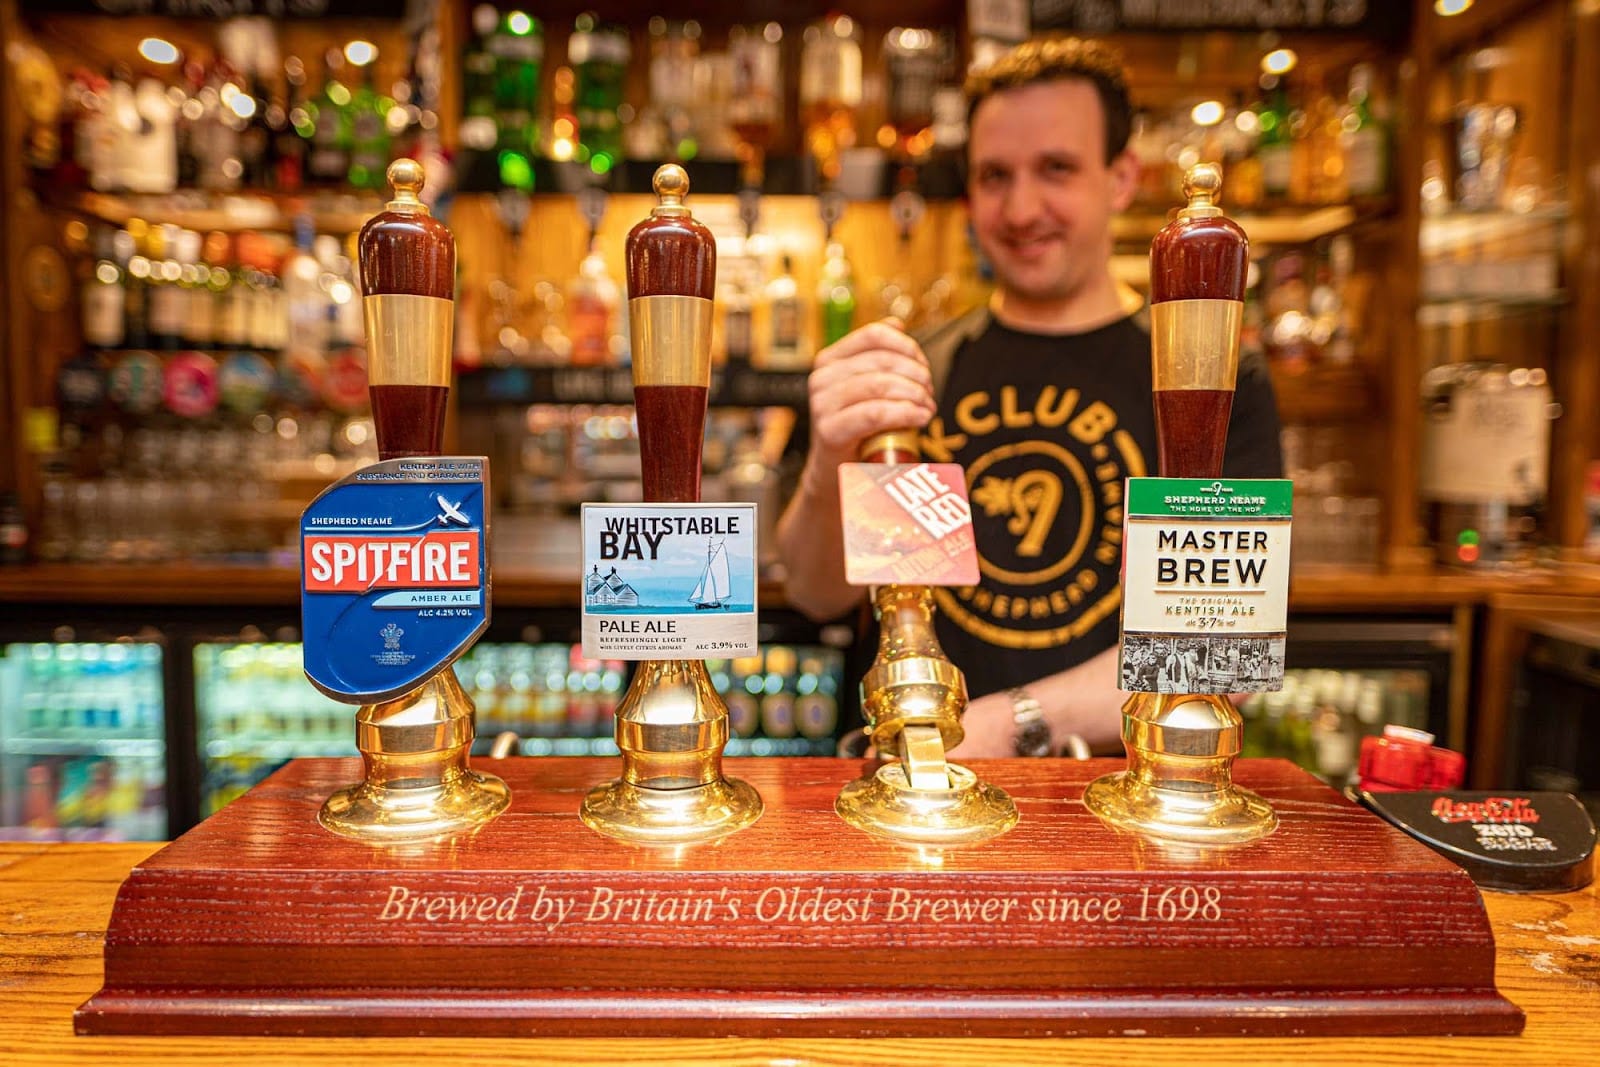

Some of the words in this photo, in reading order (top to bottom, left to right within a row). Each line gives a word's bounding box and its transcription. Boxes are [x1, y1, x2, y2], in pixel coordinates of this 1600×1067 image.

[399, 463, 436, 471] KENTISH
[427, 472, 480, 480] CHARACTER
[884, 462, 951, 513] LATE
[1164, 496, 1226, 505] SHEPHERD
[1229, 496, 1267, 505] NEAME
[311, 517, 359, 526] SHEPHERD
[360, 517, 393, 526] NEAME
[911, 492, 973, 541] RED
[605, 516, 740, 535] WHITSTABLE
[600, 531, 664, 561] BAY
[1158, 529, 1268, 550] MASTER
[311, 536, 471, 589] SPITFIRE
[1157, 557, 1268, 585] BREW
[410, 594, 447, 603] AMBER
[451, 594, 472, 602] ALE
[418, 609, 434, 617] ALC
[435, 609, 454, 617] 4.2%
[456, 609, 473, 617] VOL
[1166, 605, 1225, 615] KENTISH
[1231, 606, 1256, 615] ALE
[599, 620, 640, 633] PALE
[644, 620, 676, 633] ALE
[711, 641, 733, 650] 3.9%
[378, 885, 524, 922] Brewed
[530, 885, 575, 932] by
[585, 886, 742, 923] Britain's
[755, 886, 873, 923] Oldest
[882, 886, 1018, 923] Brewer
[1028, 888, 1122, 923] since
[1138, 885, 1223, 923] 1698
